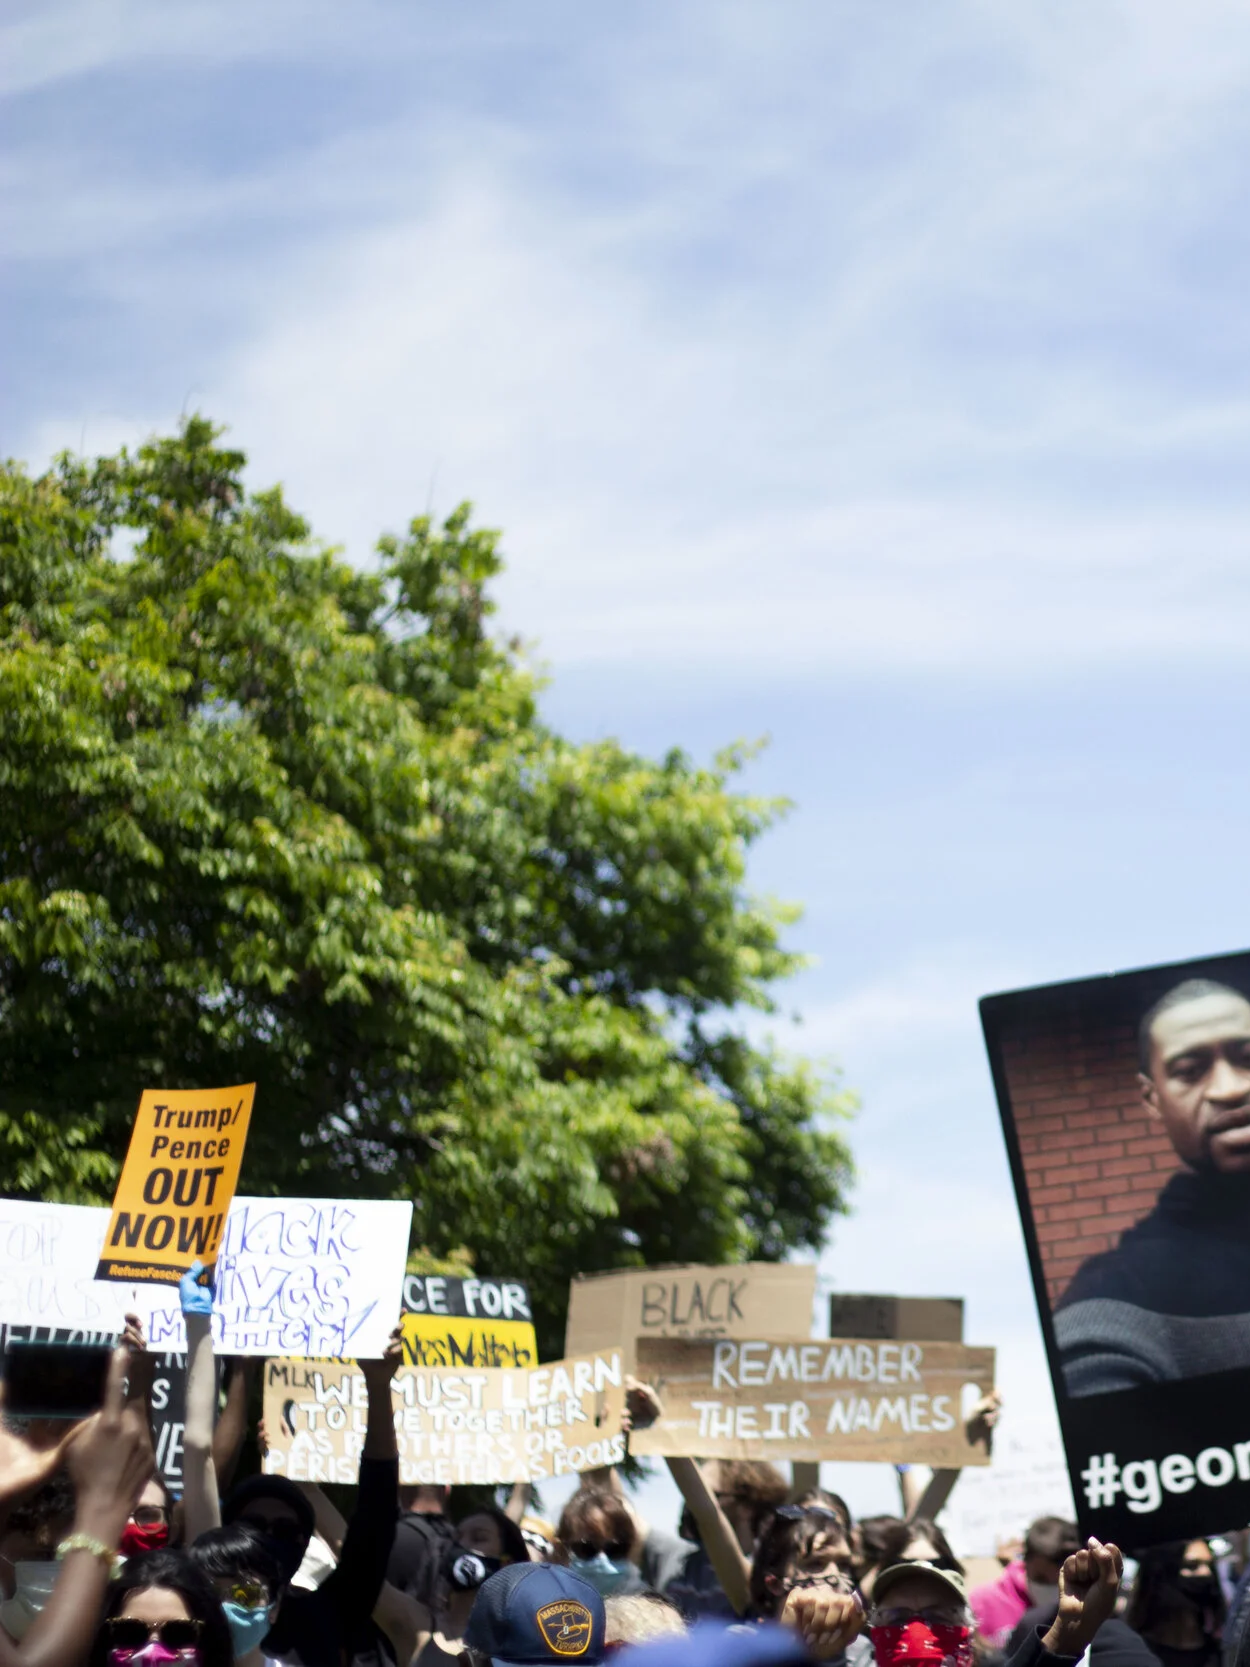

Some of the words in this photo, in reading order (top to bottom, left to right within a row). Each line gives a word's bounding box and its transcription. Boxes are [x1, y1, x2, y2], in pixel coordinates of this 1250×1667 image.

[153, 1100, 243, 1131] Trump/
[150, 1136, 230, 1159] Pence
[143, 1167, 225, 1207] OUT
[110, 1212, 223, 1255] NOW!
[224, 1203, 361, 1260] lack
[462, 1279, 532, 1319] FOR
[641, 1278, 747, 1327] BLACK
[314, 1371, 368, 1408] WE
[502, 1352, 622, 1408] LEARN
[712, 1341, 923, 1388] REMEMBER
[298, 1402, 347, 1432] TO
[426, 1397, 588, 1434] TOGETHER
[691, 1400, 811, 1438] THEIR
[264, 1449, 361, 1484] PERIS
[553, 1433, 625, 1475] FOOLS
[290, 1428, 333, 1457] AS
[523, 1428, 567, 1456] OR
